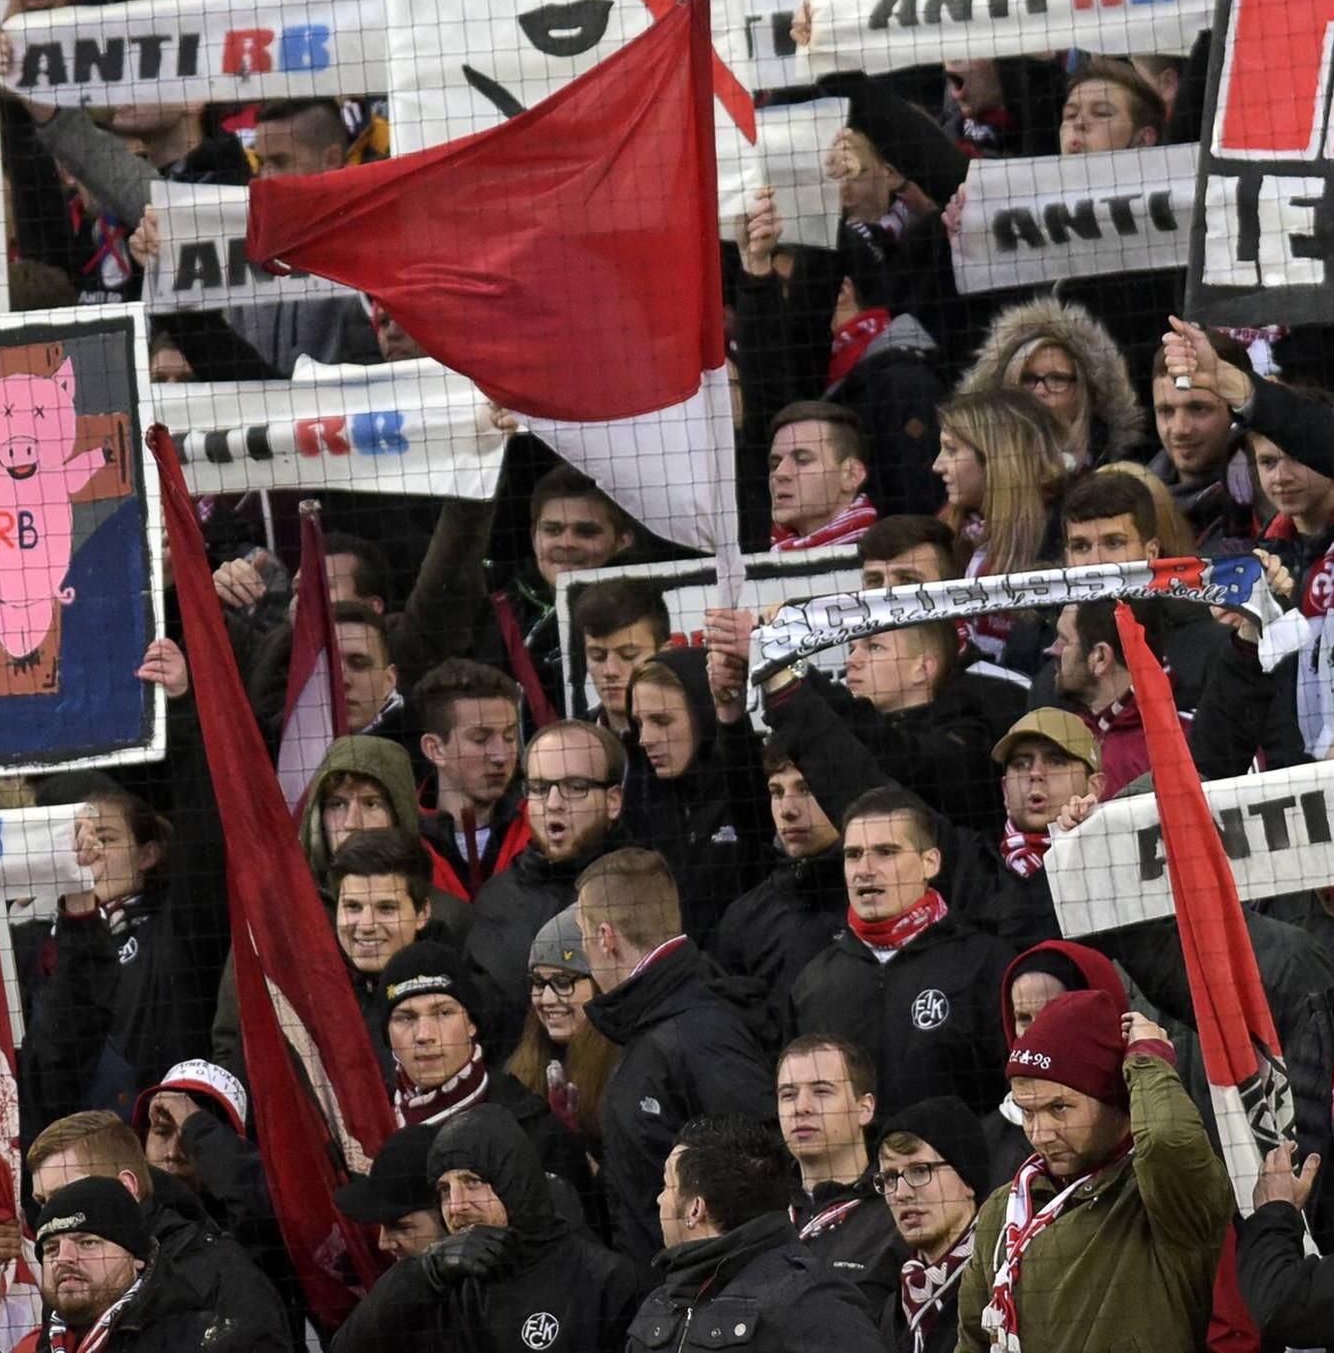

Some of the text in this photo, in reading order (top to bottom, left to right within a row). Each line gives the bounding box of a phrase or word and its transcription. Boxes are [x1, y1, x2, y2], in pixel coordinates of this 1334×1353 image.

[17, 25, 331, 88] ANTI RB
[993, 189, 1178, 252] ANTI
[294, 409, 410, 457] RB
